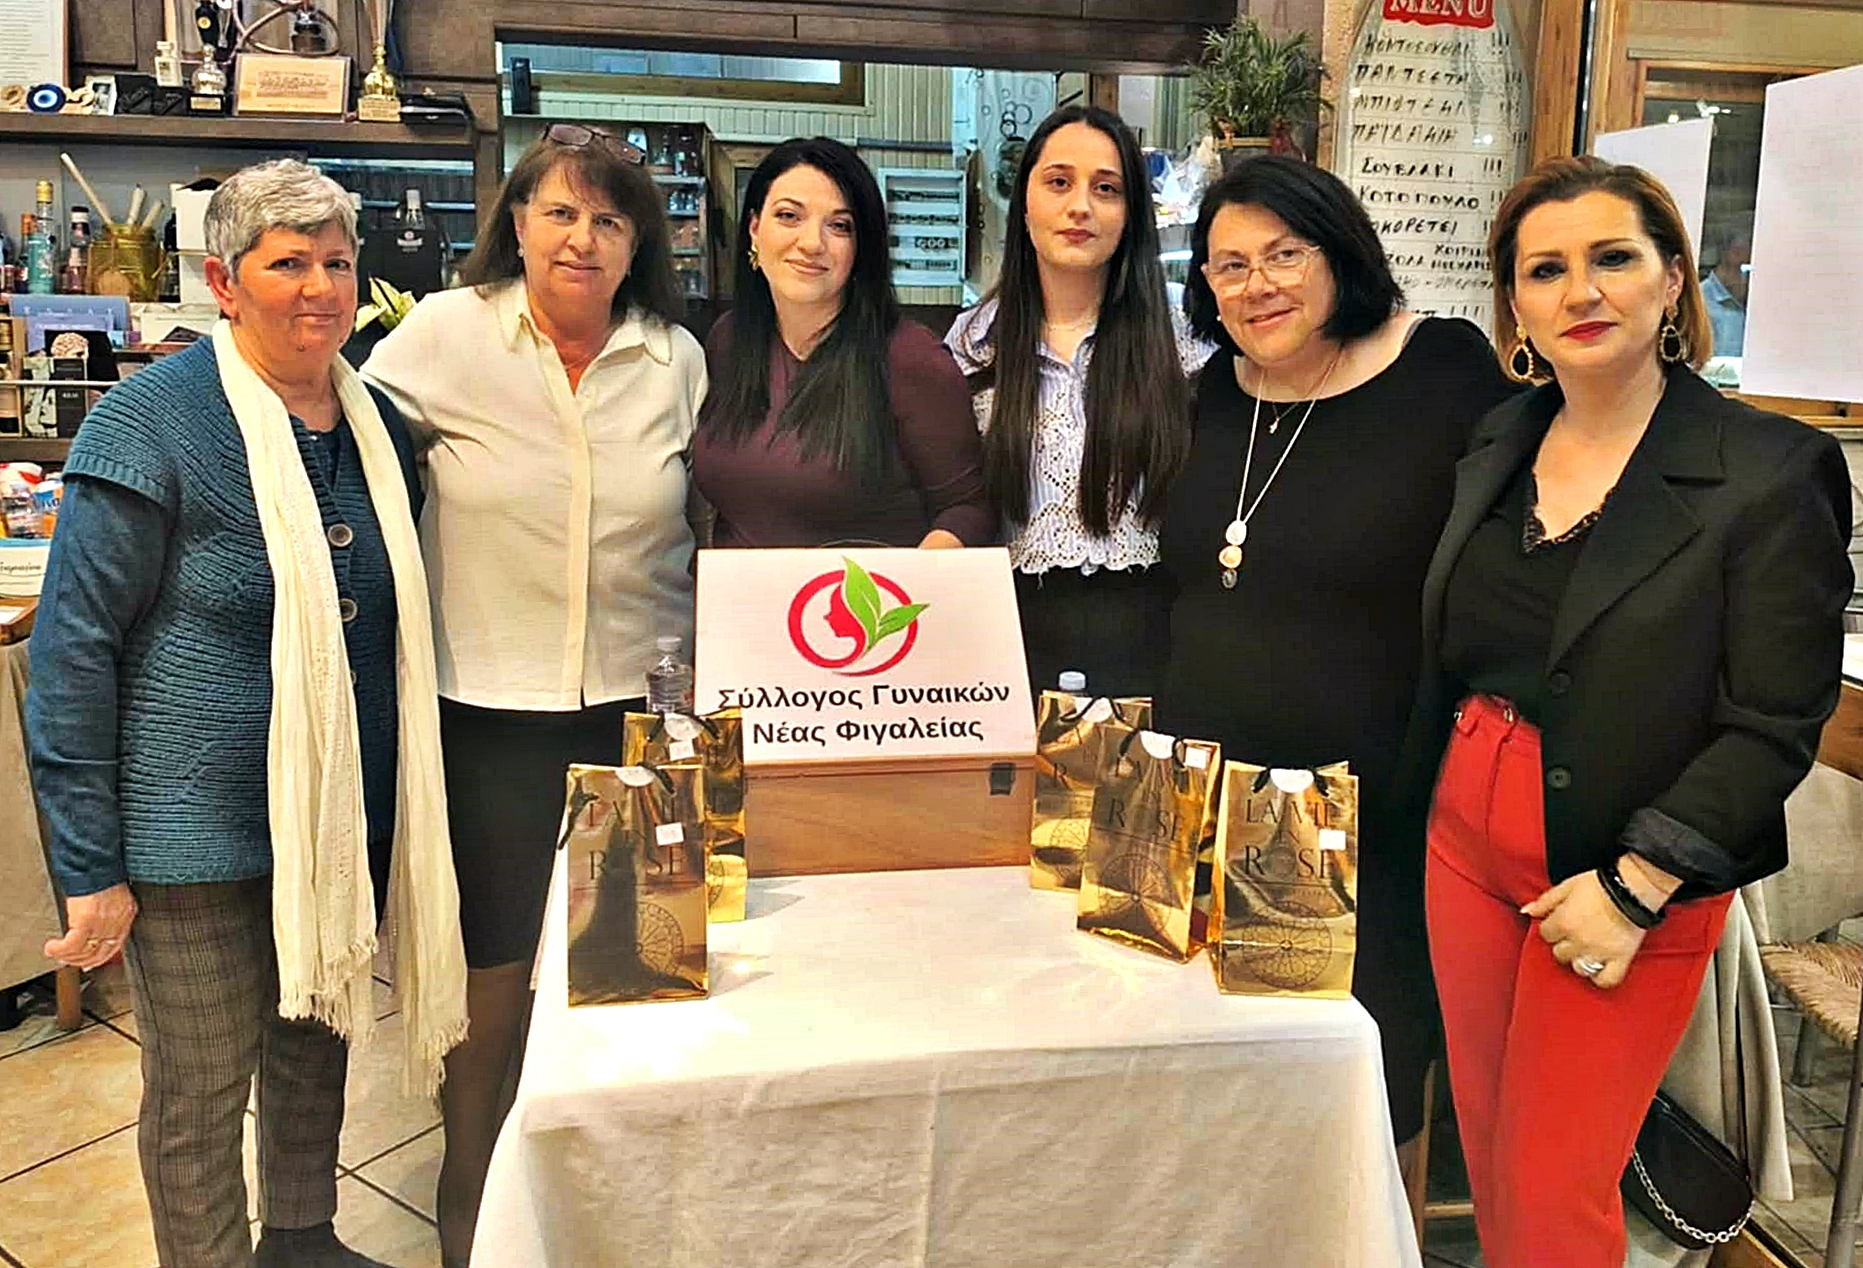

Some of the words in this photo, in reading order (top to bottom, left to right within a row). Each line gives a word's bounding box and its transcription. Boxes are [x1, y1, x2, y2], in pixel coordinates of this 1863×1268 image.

[1390, 0, 1488, 18] MENU
[1362, 157, 1454, 178] ΣΟΥΒΛΑΚΙ
[1360, 185, 1480, 210] ΚΟΤΟΠΟΥΛΟ
[1373, 217, 1458, 235] ΟΚΟΡΕΤΣΙ
[718, 686, 863, 711] Σύλλογος
[873, 681, 1010, 705] Γυναικών
[753, 720, 826, 746] Νέας
[836, 716, 984, 745] Φιγαλείας
